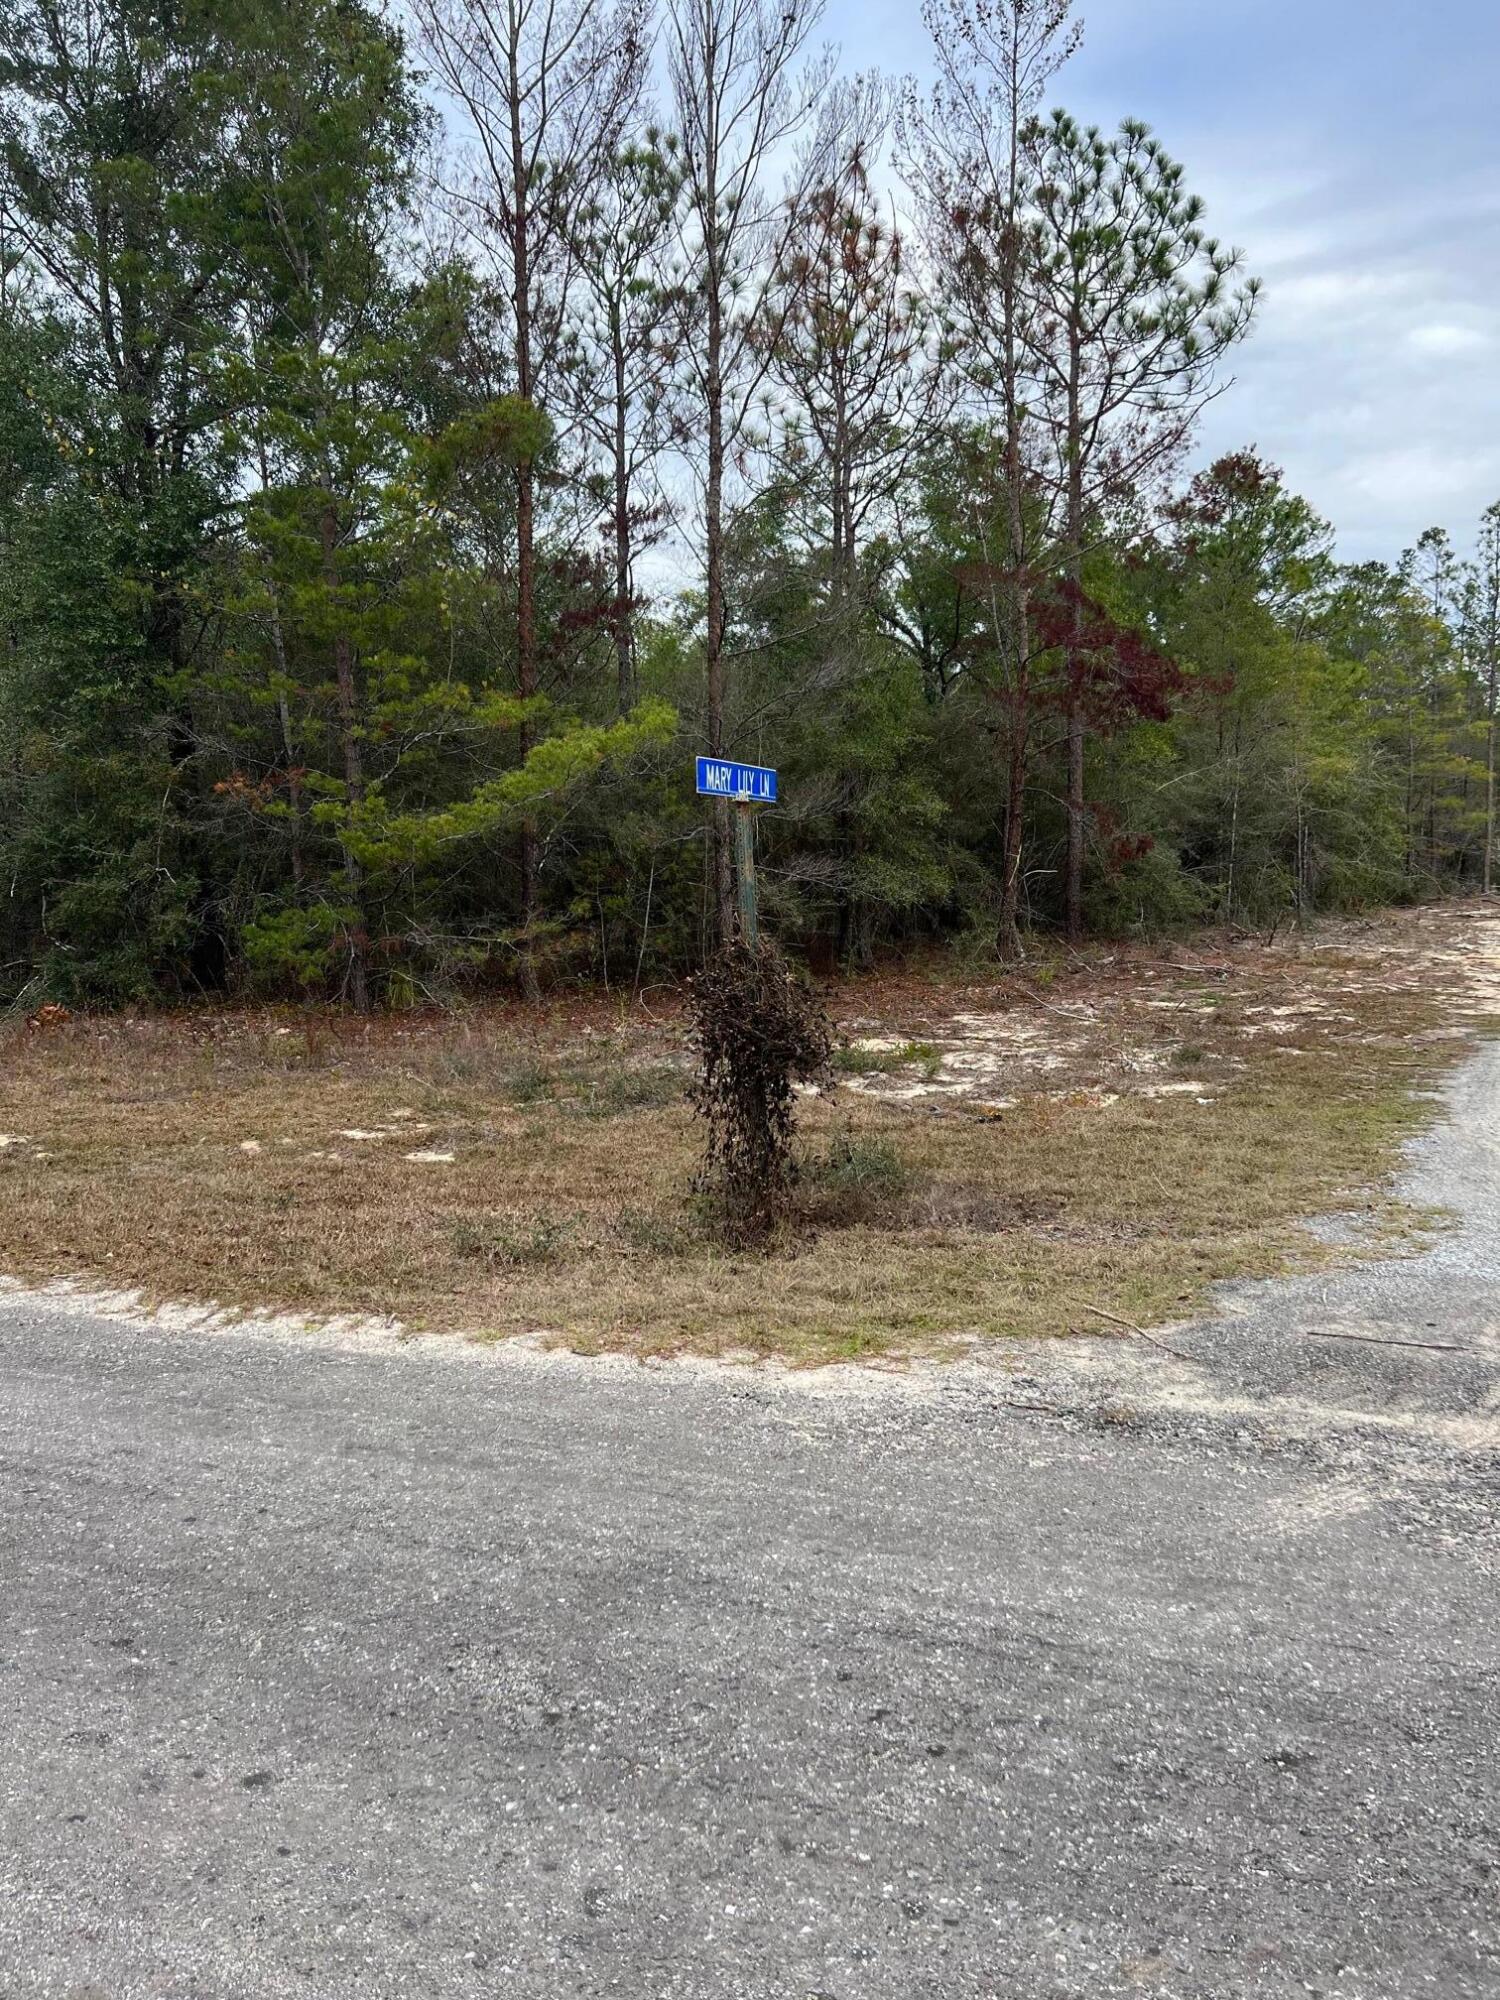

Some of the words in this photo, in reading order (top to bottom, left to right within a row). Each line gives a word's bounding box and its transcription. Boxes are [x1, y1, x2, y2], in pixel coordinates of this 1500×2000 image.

[706, 763, 732, 792] MARY
[737, 769, 755, 795] LILY
[760, 772, 770, 797] LN
